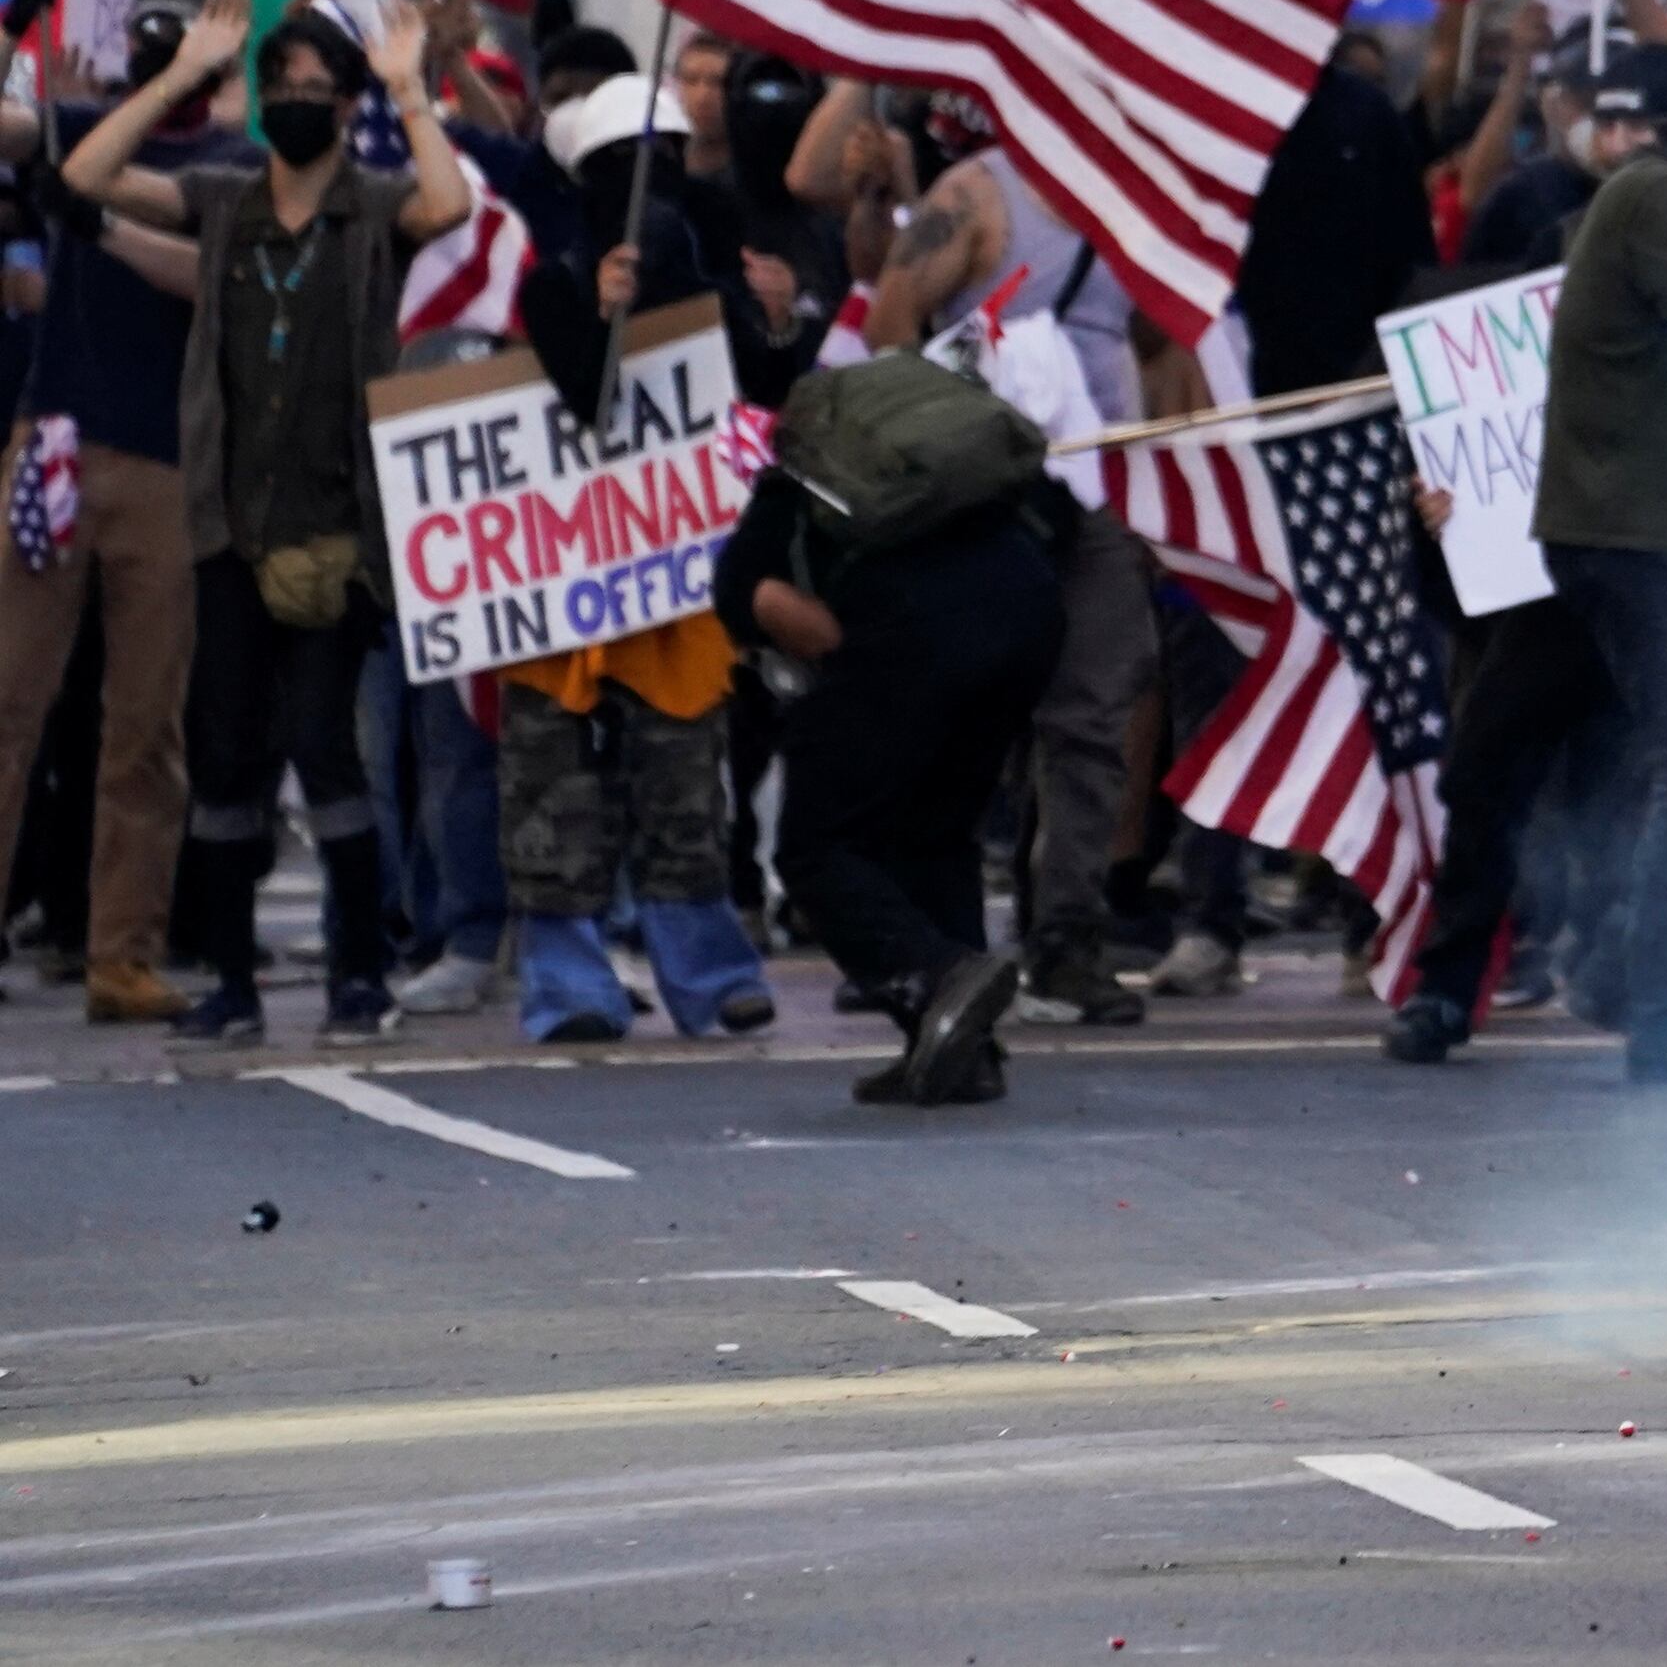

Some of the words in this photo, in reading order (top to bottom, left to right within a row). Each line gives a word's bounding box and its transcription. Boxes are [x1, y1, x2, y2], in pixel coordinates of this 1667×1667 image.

[389, 411, 528, 508] THE
[1419, 401, 1546, 506] MAK
[406, 443, 739, 606] CRIMINAL
[410, 610, 462, 673] IS
[482, 587, 551, 658] IN
[564, 532, 732, 635] OFFIC
